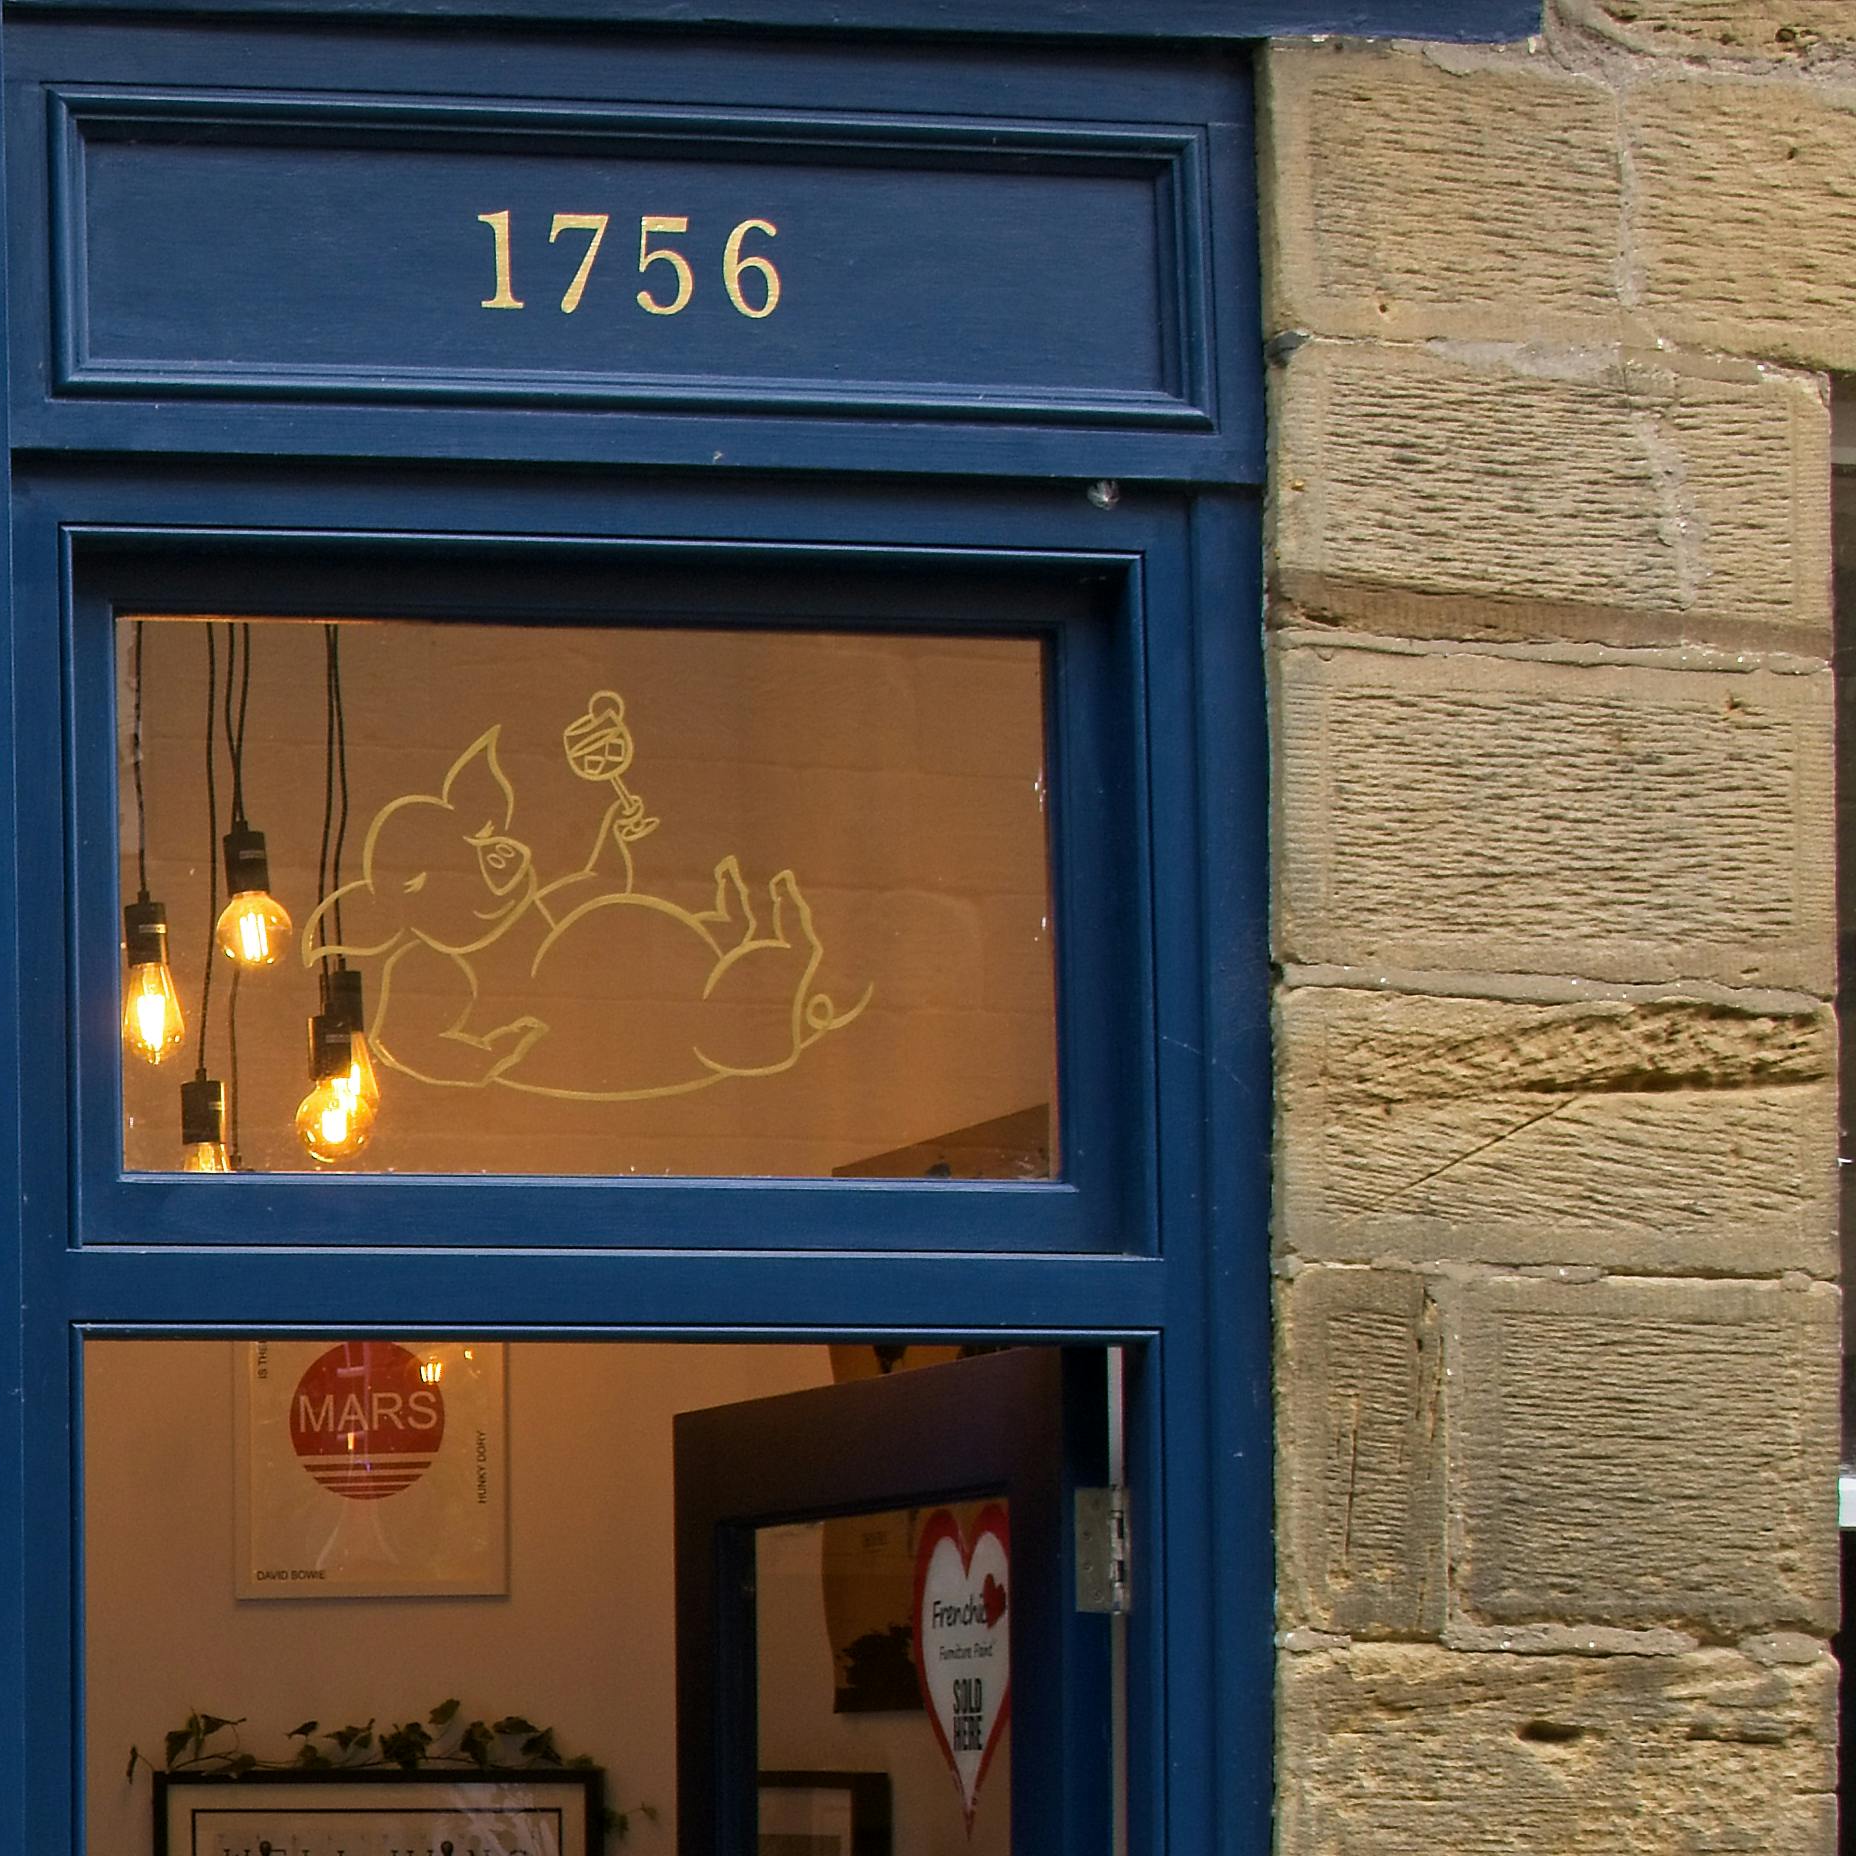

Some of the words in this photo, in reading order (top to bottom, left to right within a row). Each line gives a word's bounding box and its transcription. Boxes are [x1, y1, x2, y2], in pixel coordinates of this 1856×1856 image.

[478, 210, 783, 318] 1756
[299, 1391, 438, 1433] MARS
[477, 1430, 487, 1464] DORY
[477, 1468, 487, 1504] HUNKY
[256, 1571, 288, 1581] DAVID
[291, 1570, 325, 1580] BOWIE
[953, 1678, 983, 1714] SOLD
[953, 1715, 983, 1750] HERE
